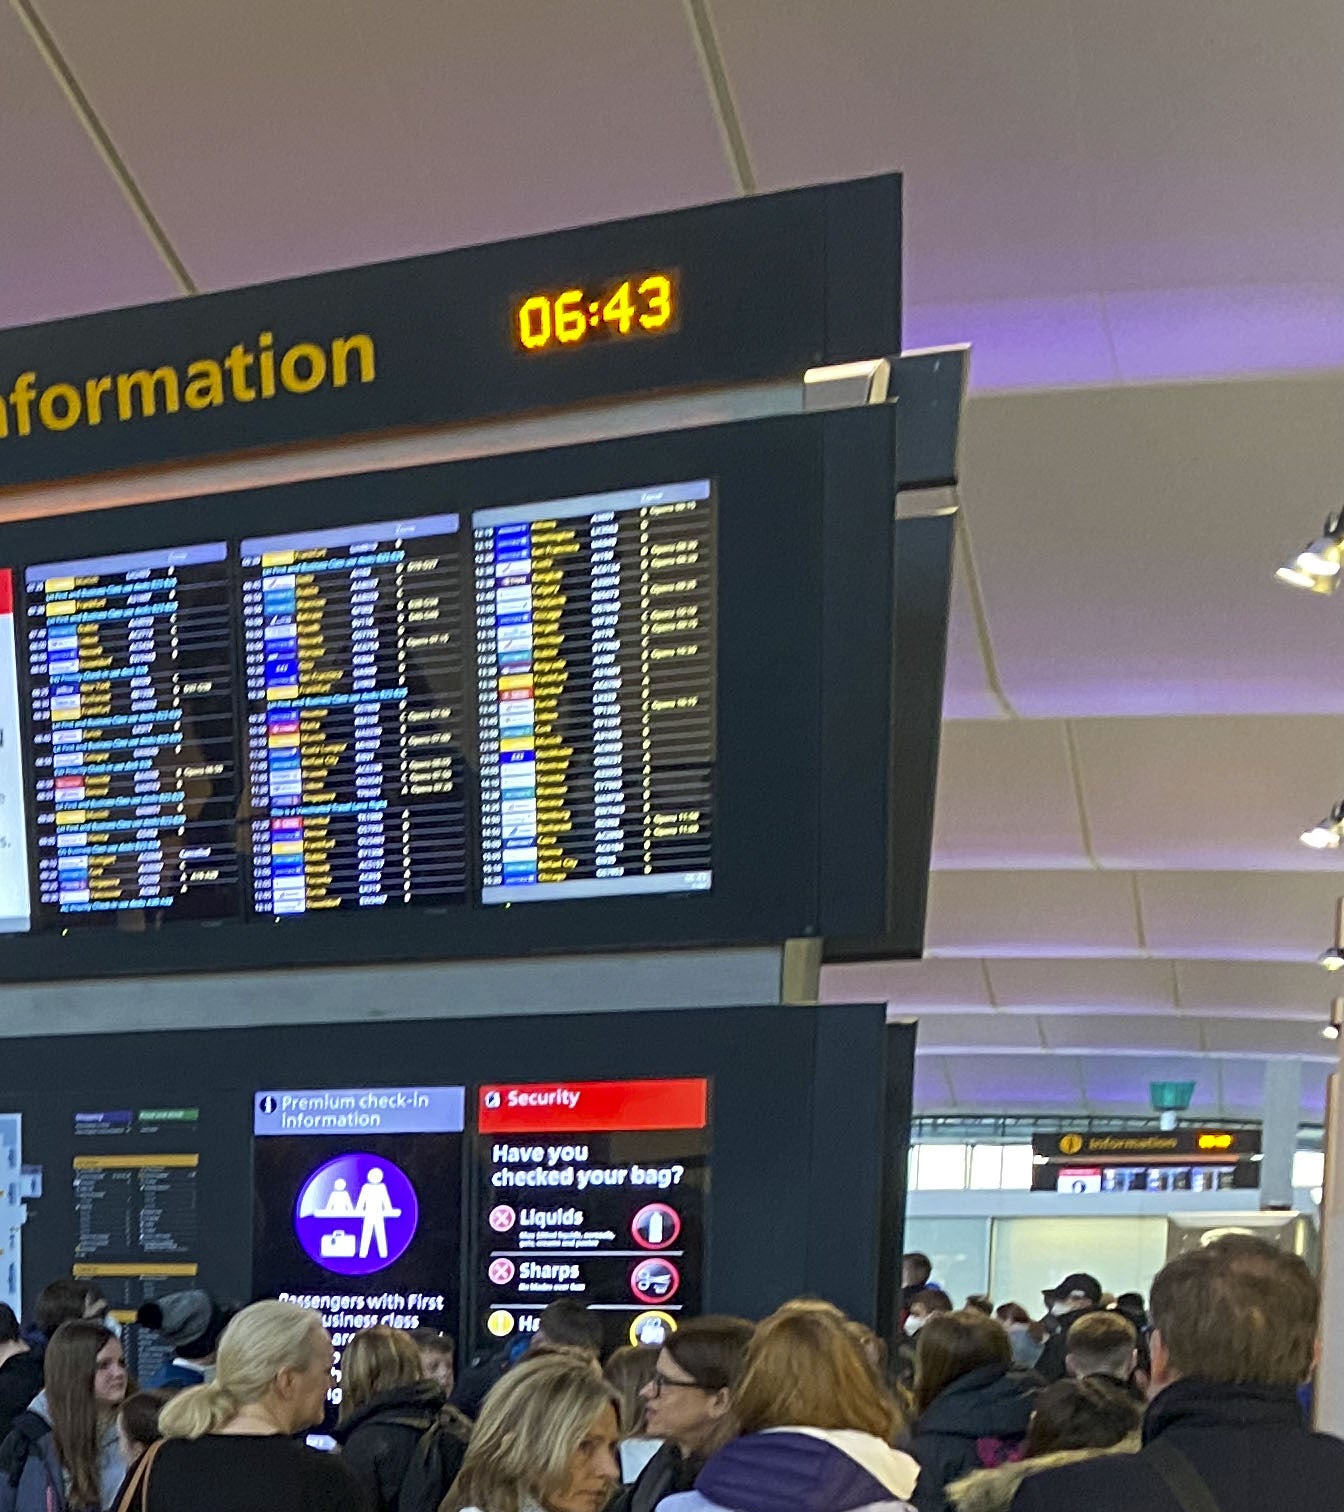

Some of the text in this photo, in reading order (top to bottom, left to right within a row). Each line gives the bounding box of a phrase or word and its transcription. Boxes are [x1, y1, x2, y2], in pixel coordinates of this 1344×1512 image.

[519, 274, 673, 349] 06:43
[281, 1091, 429, 1112] Premium check-in
[507, 1088, 581, 1109] Security
[492, 1144, 589, 1167] Have you
[491, 1165, 685, 1190] checked your bag?
[520, 1208, 584, 1229] Liquids
[519, 1262, 580, 1283] Sharps
[366, 1293, 406, 1310] with
[407, 1293, 445, 1311] First
[381, 1312, 420, 1329] class
